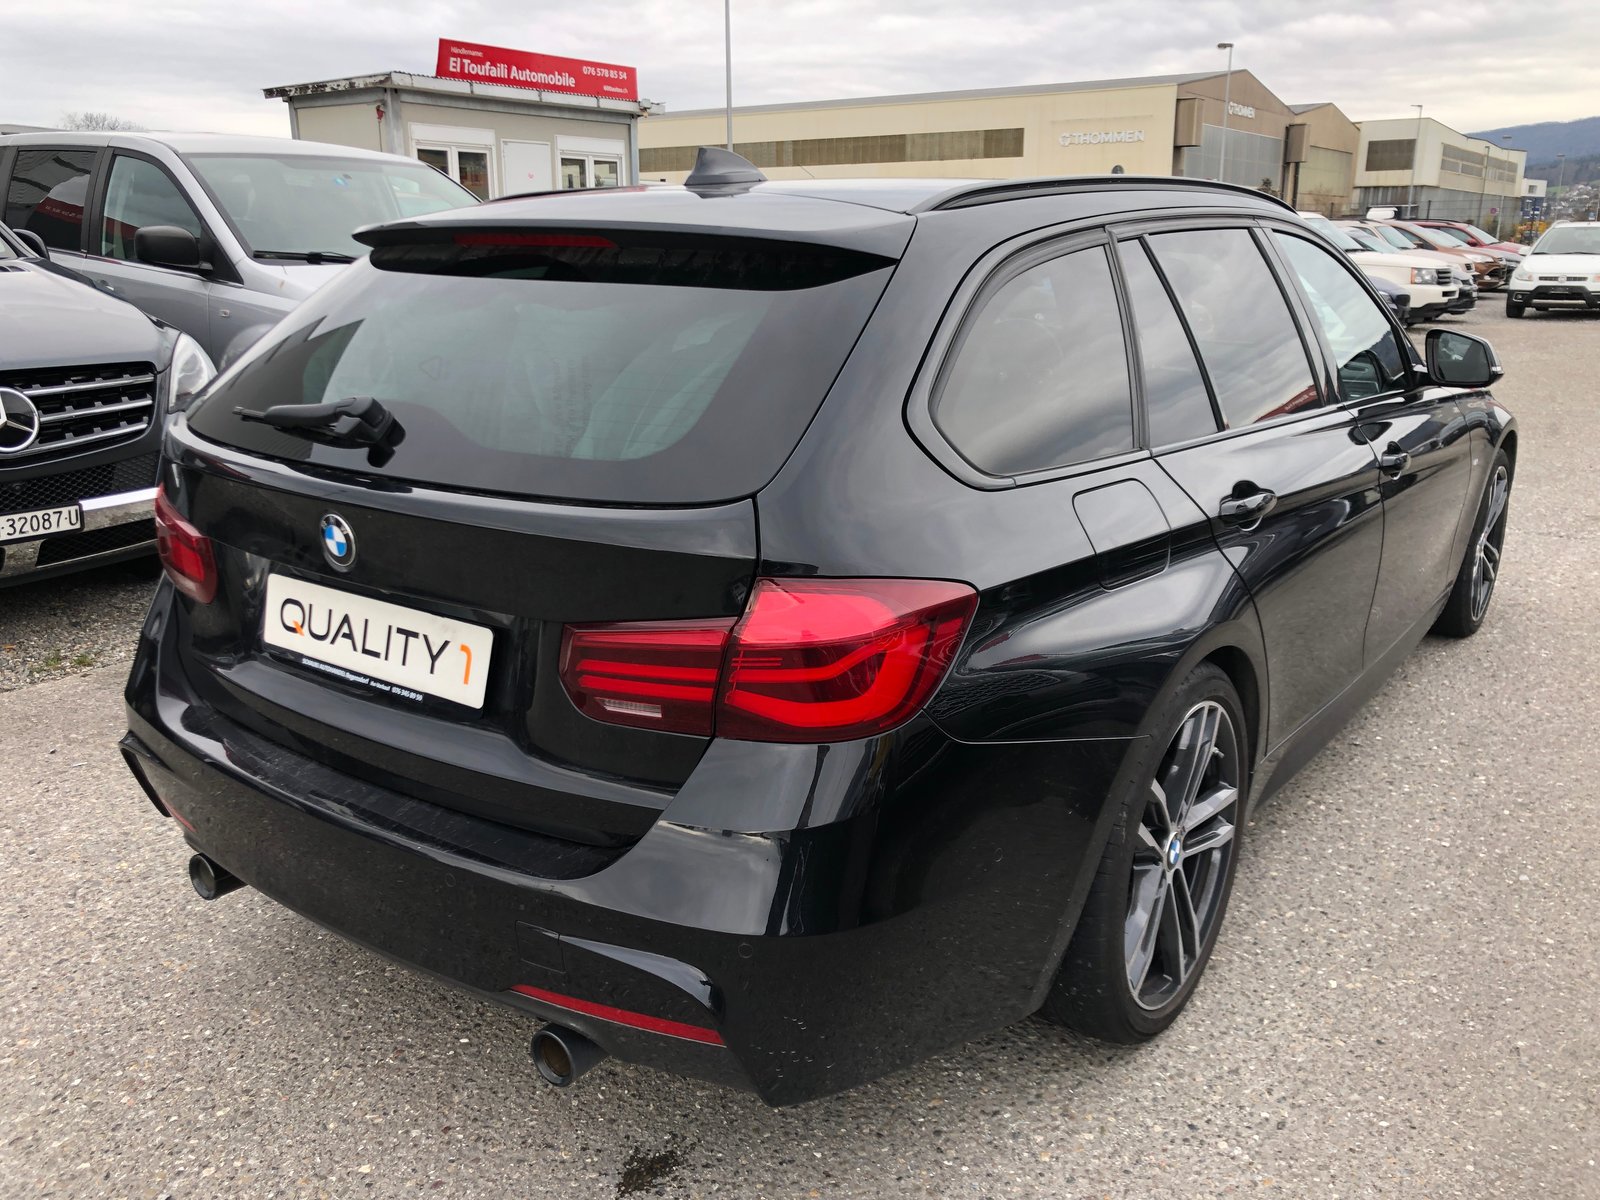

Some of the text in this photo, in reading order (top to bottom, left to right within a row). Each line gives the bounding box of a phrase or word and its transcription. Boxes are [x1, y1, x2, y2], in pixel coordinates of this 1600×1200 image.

[449, 57, 576, 88] El Toufaili Automobile
[582, 65, 597, 76] 076
[596, 67, 610, 78] 578
